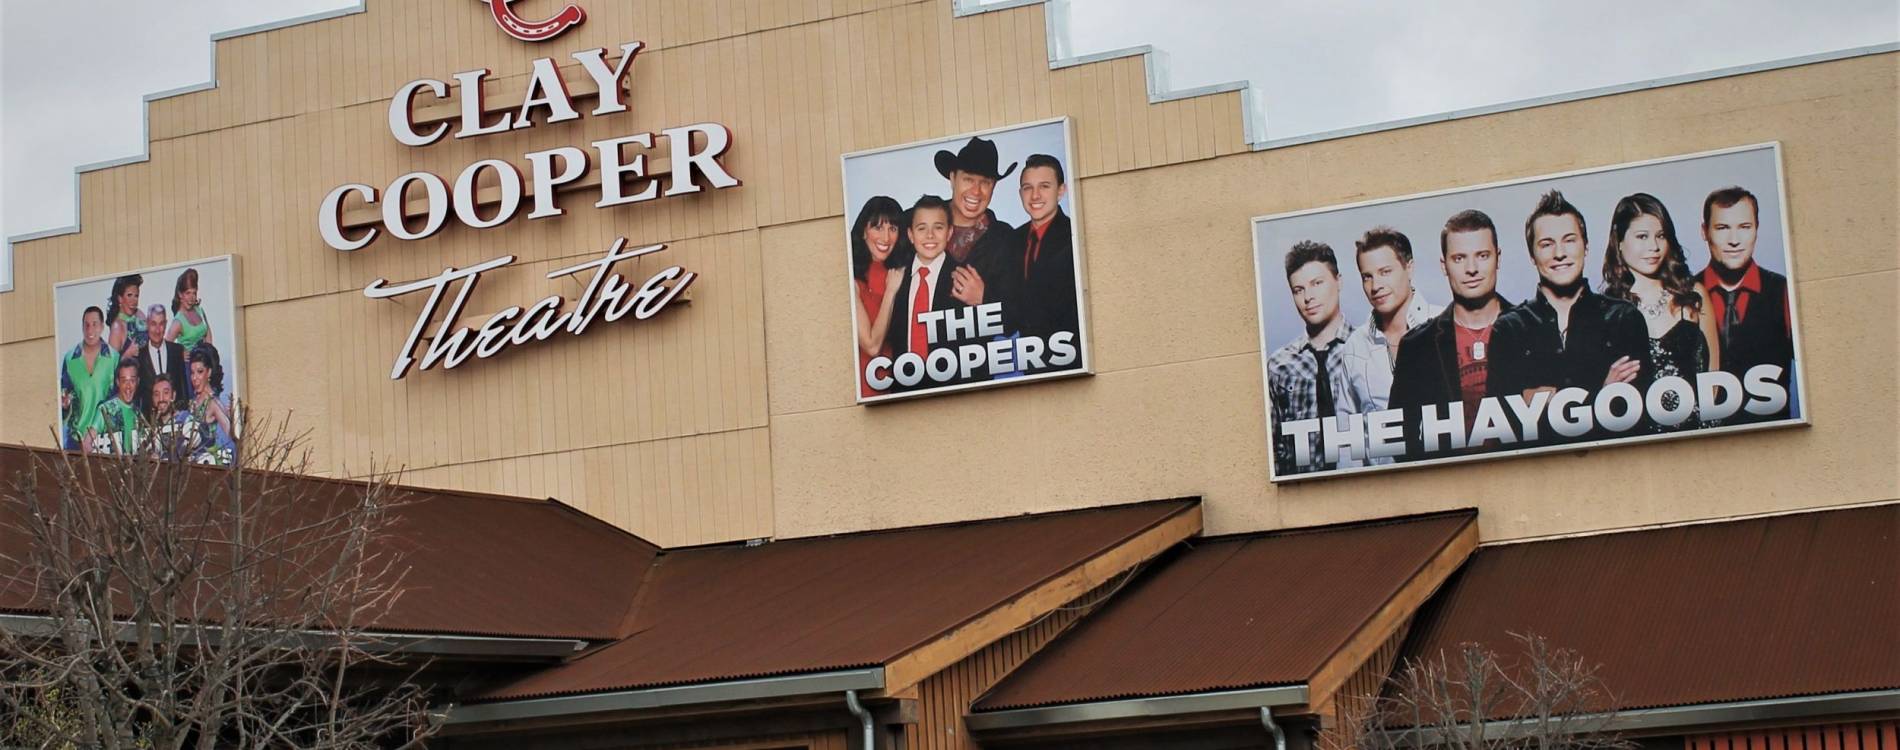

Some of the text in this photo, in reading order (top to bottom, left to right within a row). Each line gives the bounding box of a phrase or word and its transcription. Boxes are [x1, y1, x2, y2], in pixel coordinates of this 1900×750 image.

[388, 41, 645, 147] CLAY
[318, 122, 742, 252] COOPER
[364, 237, 698, 380] Theatre
[918, 302, 1004, 344] THE
[865, 331, 1077, 391] COOPERS
[1281, 364, 1788, 467] THE HAYGOODS
